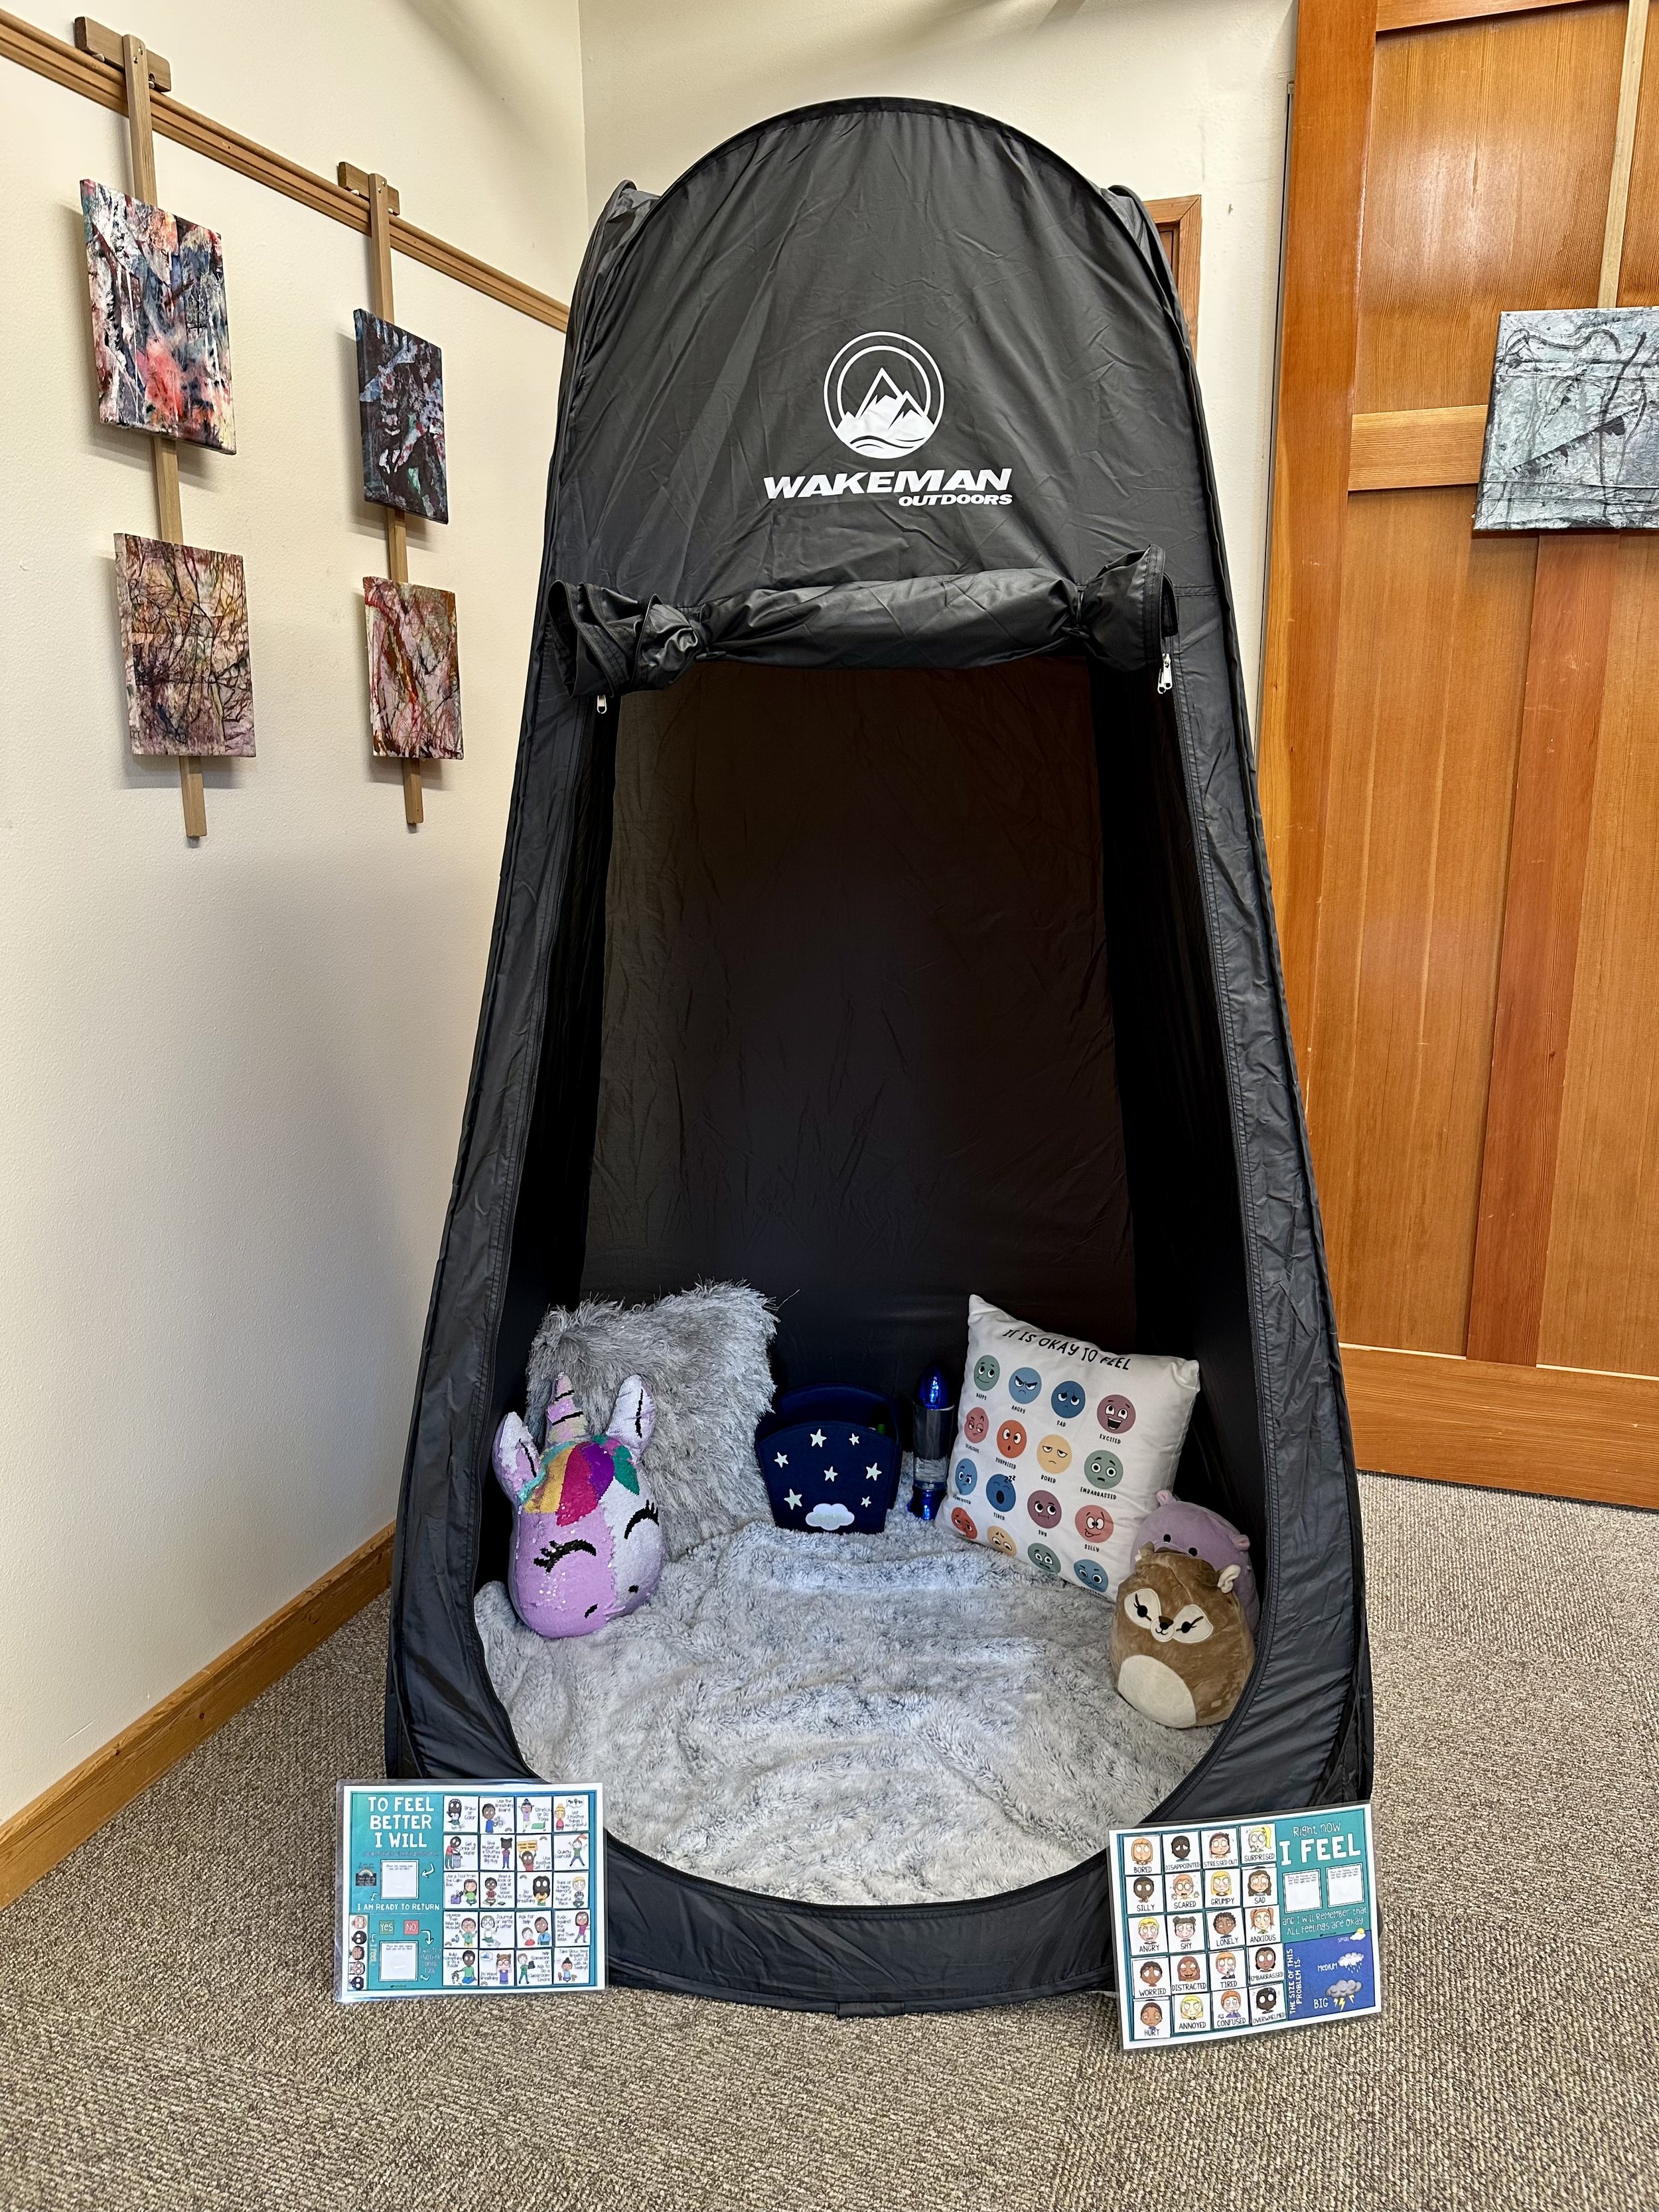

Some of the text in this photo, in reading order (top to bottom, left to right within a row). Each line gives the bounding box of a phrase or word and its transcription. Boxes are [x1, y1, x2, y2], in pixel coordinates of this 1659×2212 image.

[764, 469, 1012, 499] WAKEMAN
[899, 494, 1012, 506] OUTDOORS
[1002, 1329, 1131, 1370] IT IS OKAY TO FEEL
[1011, 1405, 1025, 1414] ANGRY
[1099, 1434, 1121, 1444] EXCITED
[995, 1457, 1016, 1469] SURPRISED
[1041, 1474, 1056, 1483] BORED
[1080, 1487, 1117, 1500] EMBARRASSED
[993, 1512, 1005, 1521] TIRED
[1084, 1544, 1100, 1552] SILLY
[368, 1796, 435, 1812] TO FEEL
[370, 1814, 432, 1830] BETTER
[1293, 1825, 1318, 1837] Right
[374, 1832, 427, 1848] I WILL
[1279, 1833, 1361, 1866] I FEEL
[1244, 1853, 1275, 1862] SURPRISED
[1165, 1862, 1200, 1871] DISAPPOINTED
[1174, 1901, 1196, 1909] SCARED
[406, 1923, 416, 1931] NO
[1216, 1937, 1239, 1947] LONELY
[1250, 1934, 1276, 1943] ANXIOUS
[1250, 1972, 1284, 1982] EMBARRASSED
[1287, 1969, 1294, 1979] OF
[1172, 1982, 1206, 1992] DISTRACTED
[1220, 1980, 1238, 1989] TIRED
[1139, 1988, 1167, 1997] WORRIED
[1313, 1997, 1329, 2009] BIG
[1216, 2017, 1246, 2028] CONFUSED
[1252, 2012, 1285, 2024] OVERWHELMED
